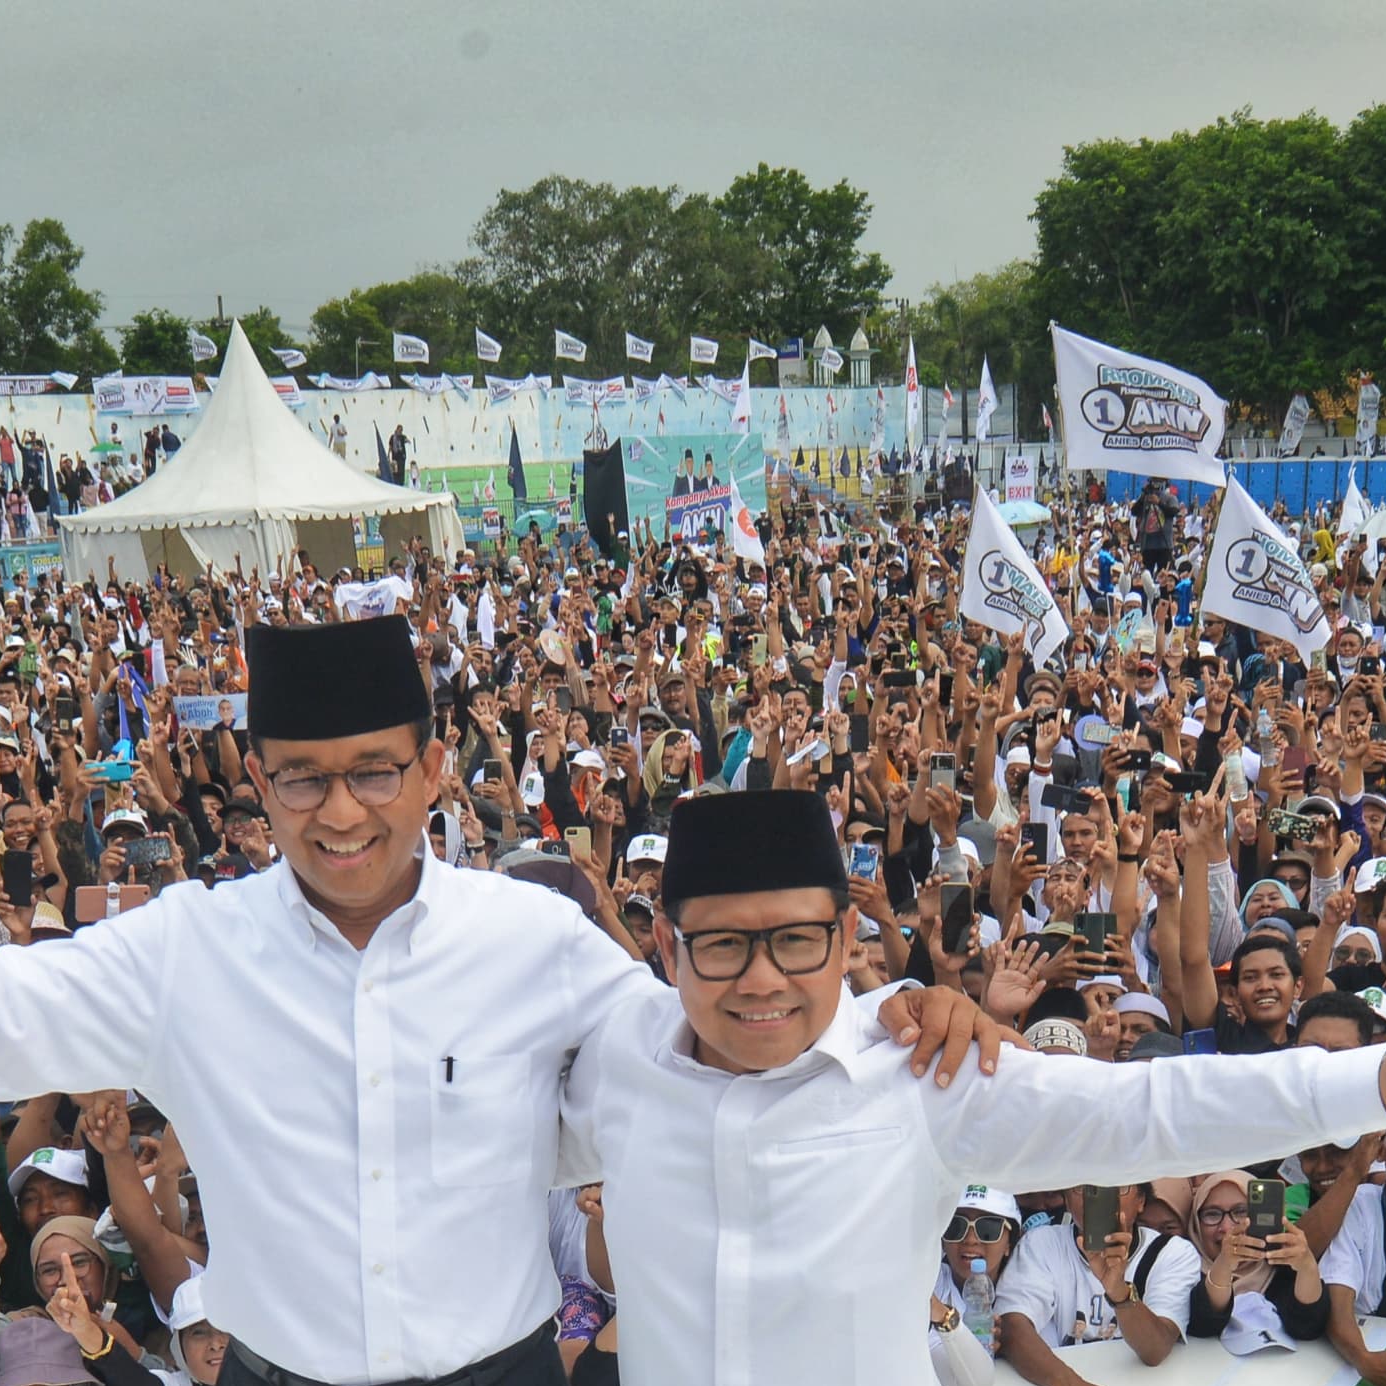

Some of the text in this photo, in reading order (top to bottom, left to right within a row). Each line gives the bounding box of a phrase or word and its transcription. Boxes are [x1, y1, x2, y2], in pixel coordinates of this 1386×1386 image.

[1093, 398, 1115, 427] 1
[1130, 398, 1204, 433] AMIN
[1107, 436, 1139, 448] ANIES
[1141, 437, 1152, 448] &
[1008, 486, 1032, 499] EXIT
[32, 556, 62, 566] COBLOS
[1235, 547, 1256, 578] 1
[987, 560, 1005, 588] 1
[1237, 587, 1271, 602] ANIES
[1258, 1330, 1278, 1344] 1
